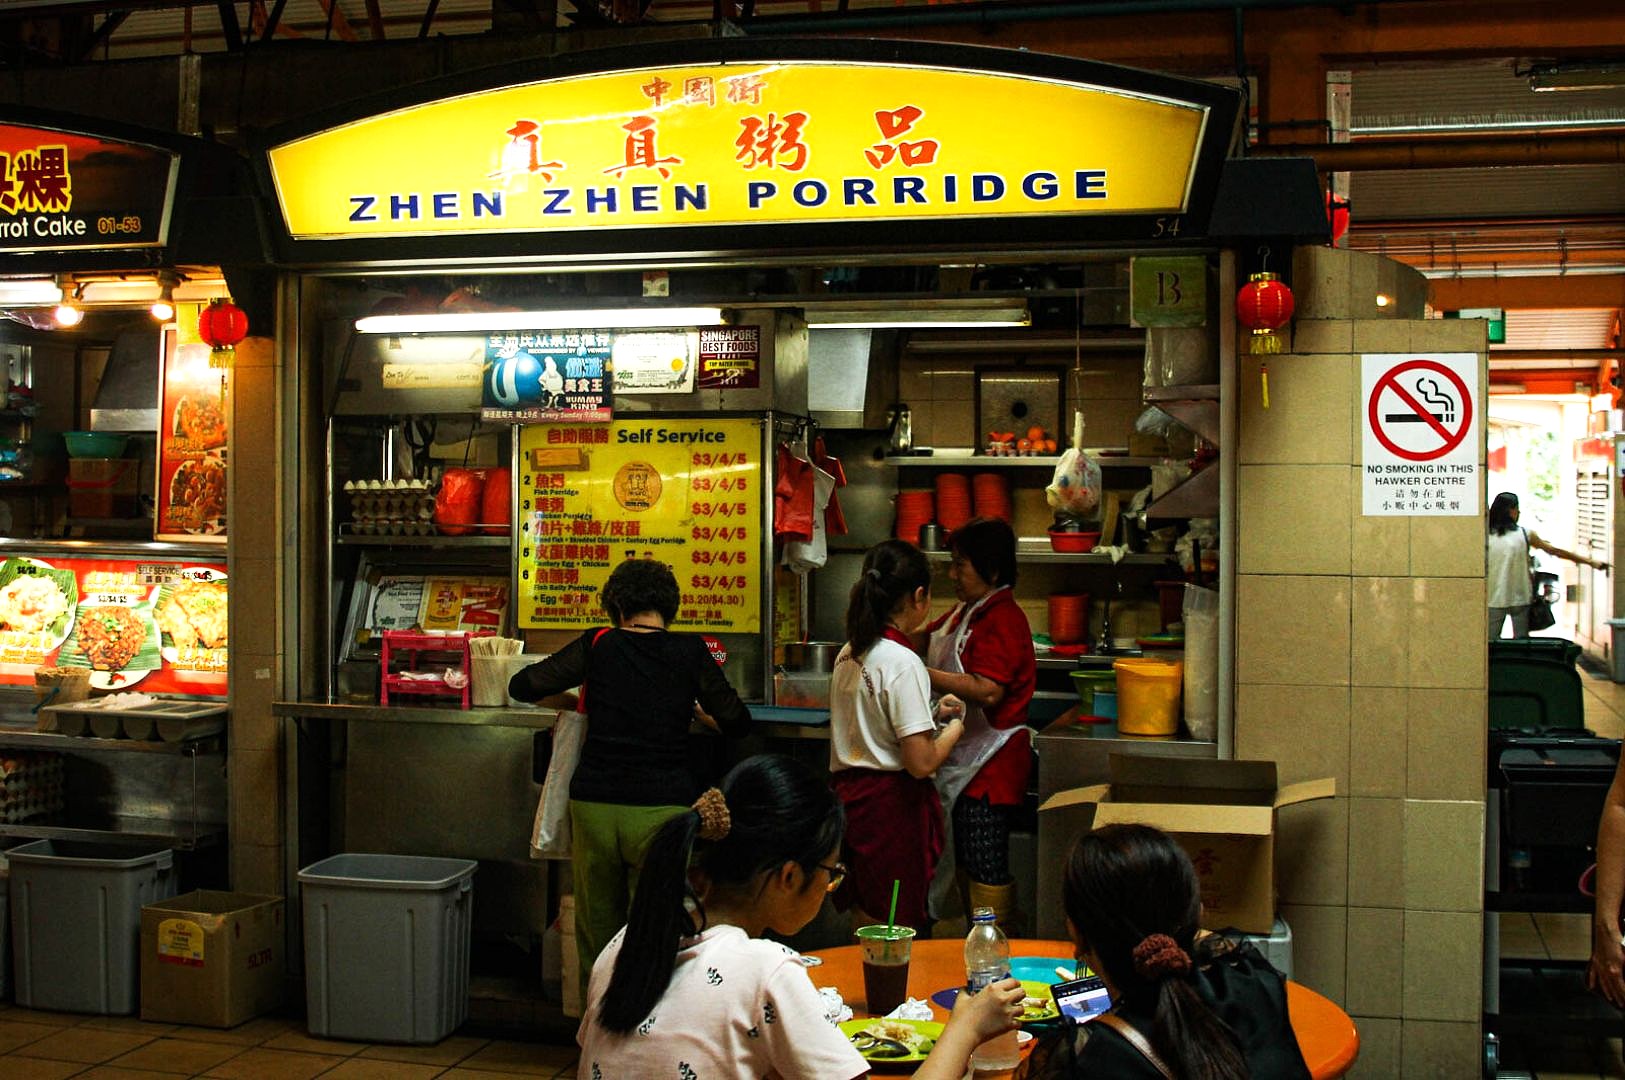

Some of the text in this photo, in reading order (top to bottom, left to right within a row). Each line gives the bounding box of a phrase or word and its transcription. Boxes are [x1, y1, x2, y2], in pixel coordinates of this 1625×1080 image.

[349, 170, 1108, 222] ZHEN ZHEN PORRIDGE
[34, 215, 87, 237] Cake
[97, 216, 142, 234] 01-53
[1152, 217, 1181, 238] 54
[701, 330, 759, 342] SINGAPORE
[702, 342, 756, 352] BEST FOODS
[617, 429, 652, 444] Self
[657, 429, 726, 444] Service
[524, 452, 530, 461] 1
[691, 453, 747, 468] $3/4/5
[1367, 464, 1474, 474] NO SMOKING IN THIS
[523, 476, 531, 485] 2
[691, 478, 747, 493] $3/4/5
[1375, 476, 1466, 486] HAWKER CENTRE
[523, 500, 530, 510] 3
[691, 502, 747, 518] $3/4/5
[522, 523, 529, 533] 4
[691, 527, 747, 543] $3/4/5
[522, 548, 529, 557] 5
[691, 551, 747, 567] $3/4/5
[522, 571, 529, 580] 6
[691, 575, 747, 591] $3/4/5
[540, 594, 557, 605] Egg
